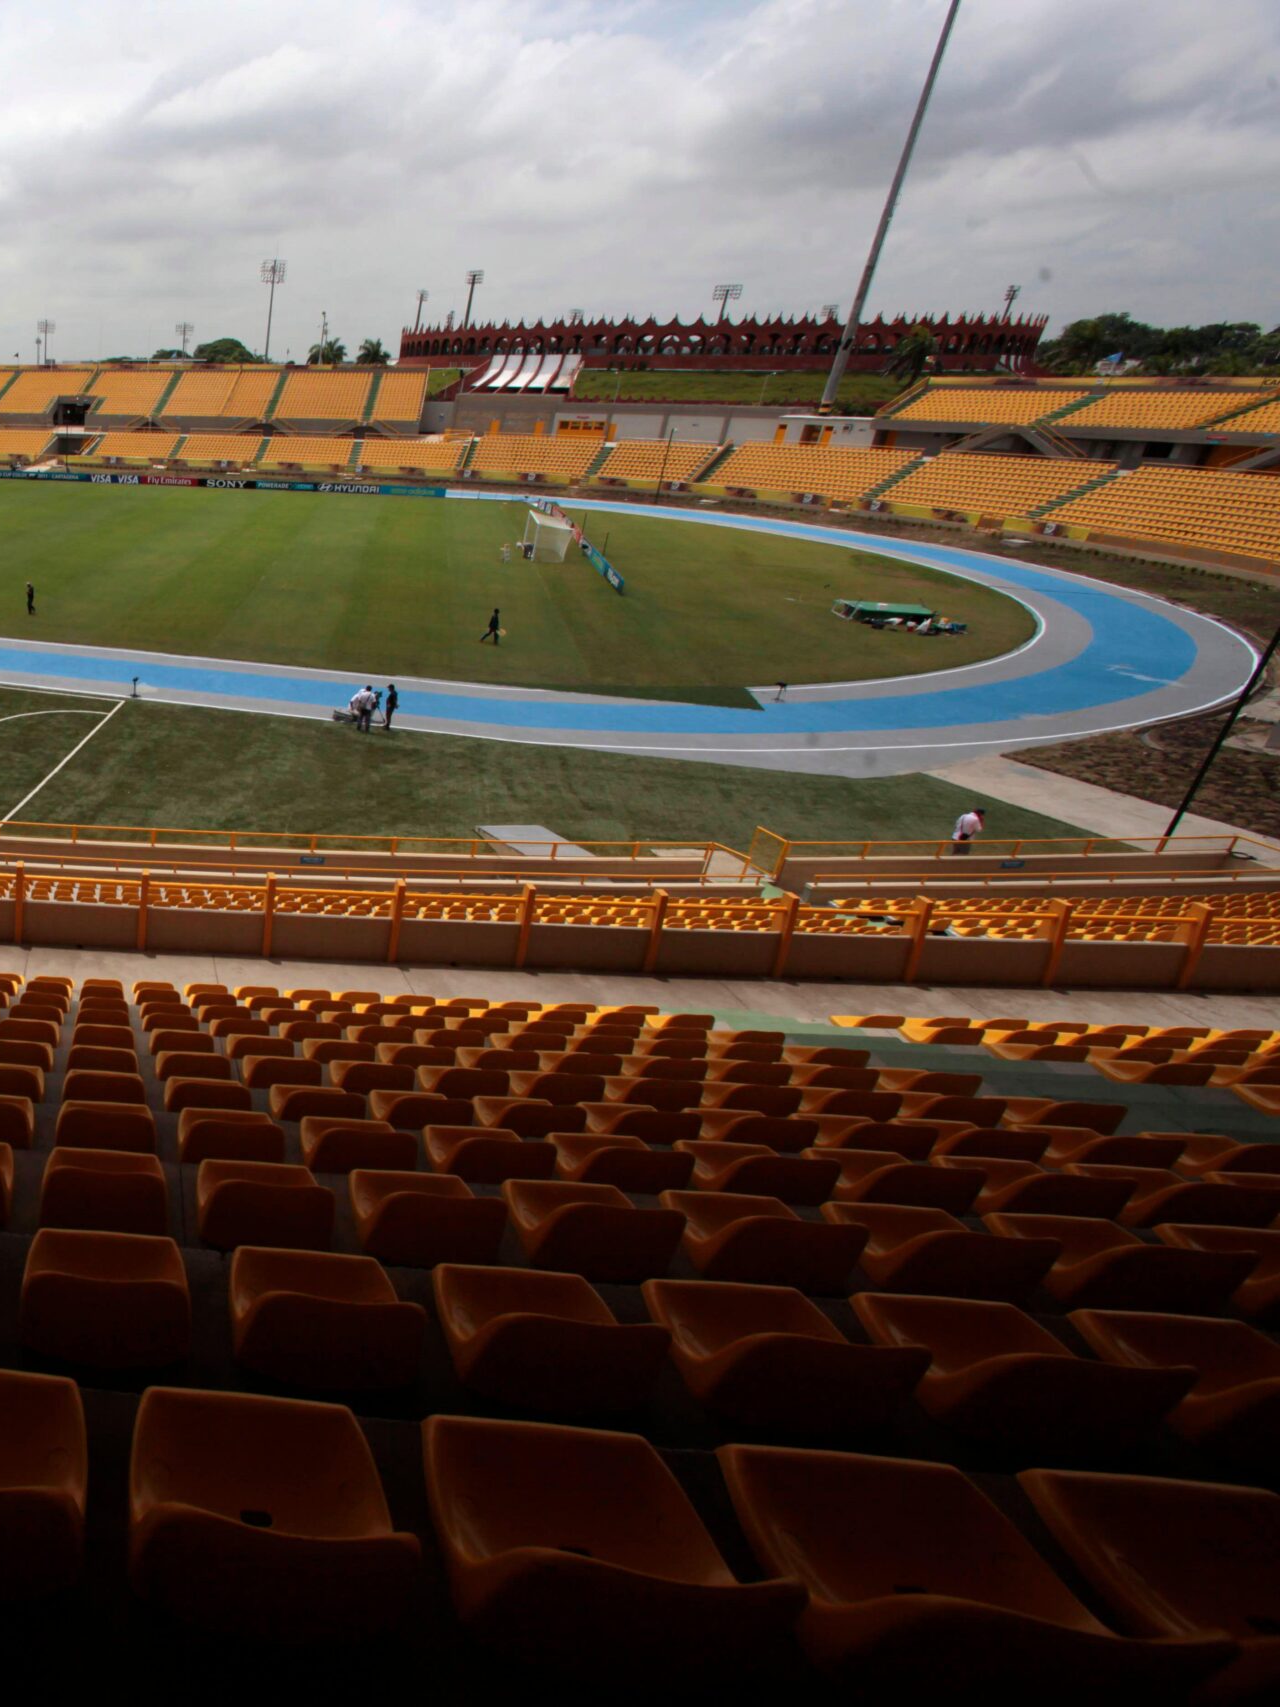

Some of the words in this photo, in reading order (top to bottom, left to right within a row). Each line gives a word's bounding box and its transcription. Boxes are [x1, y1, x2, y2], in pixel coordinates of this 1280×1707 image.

[91, 474, 111, 483] VISA
[118, 475, 139, 484] VISA
[147, 476, 159, 486] Fly
[160, 477, 192, 486] Emirates
[206, 479, 247, 488] SONY
[334, 484, 380, 494] HYUNDAI
